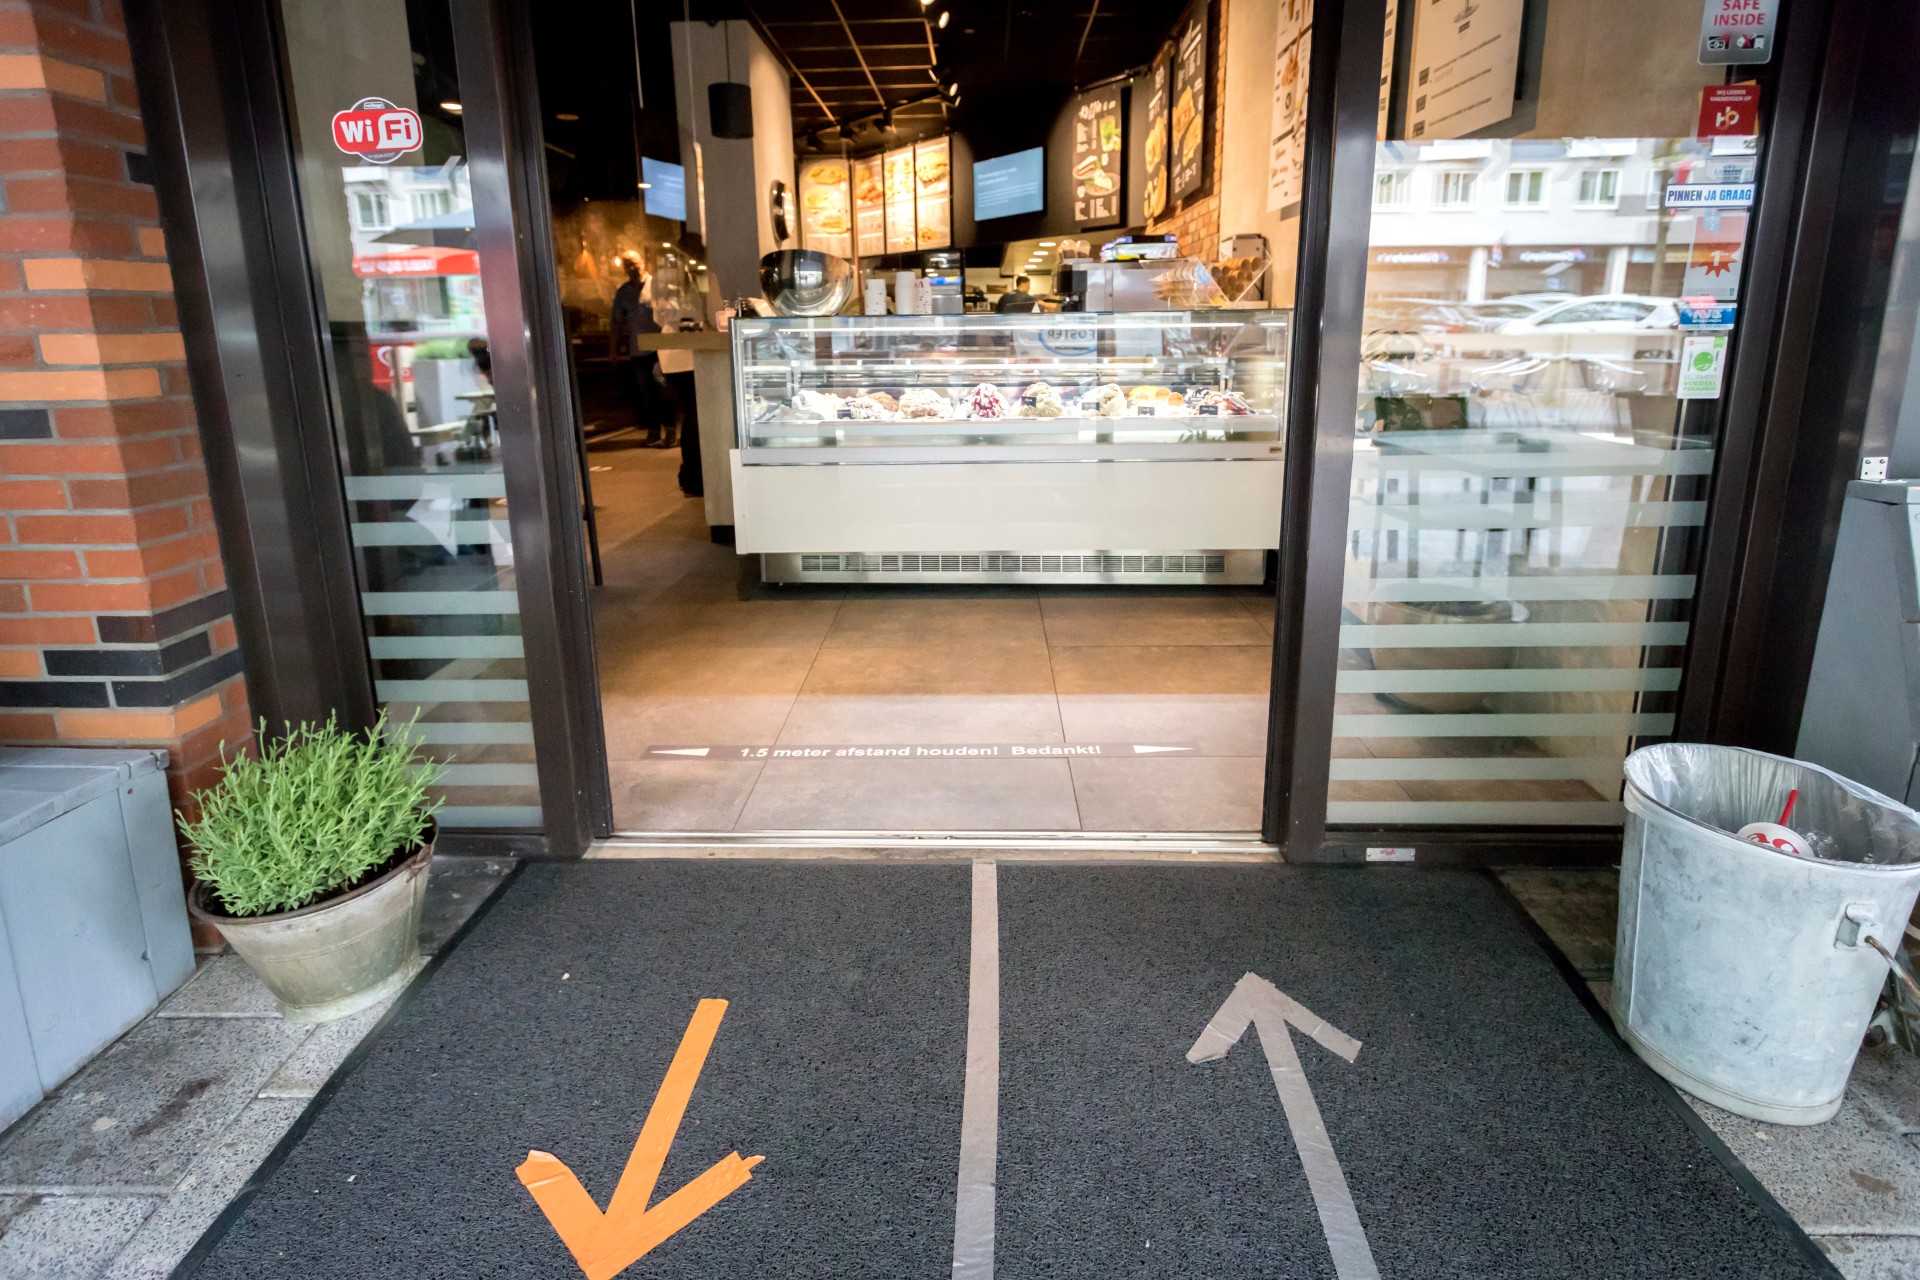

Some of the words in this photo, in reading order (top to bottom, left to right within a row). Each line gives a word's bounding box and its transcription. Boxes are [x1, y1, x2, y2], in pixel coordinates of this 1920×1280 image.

[1722, 0, 1760, 11] SAFE
[1713, 13, 1765, 26] INSIDE
[1667, 190, 1702, 201] PINNEN
[1704, 189, 1717, 201] JA
[1719, 189, 1752, 200] GRAAG
[740, 747, 768, 758] 1.5
[772, 748, 831, 758] meter
[835, 747, 911, 757] afstand
[916, 745, 998, 756] houden!
[1011, 744, 1102, 755] Bedankt!
